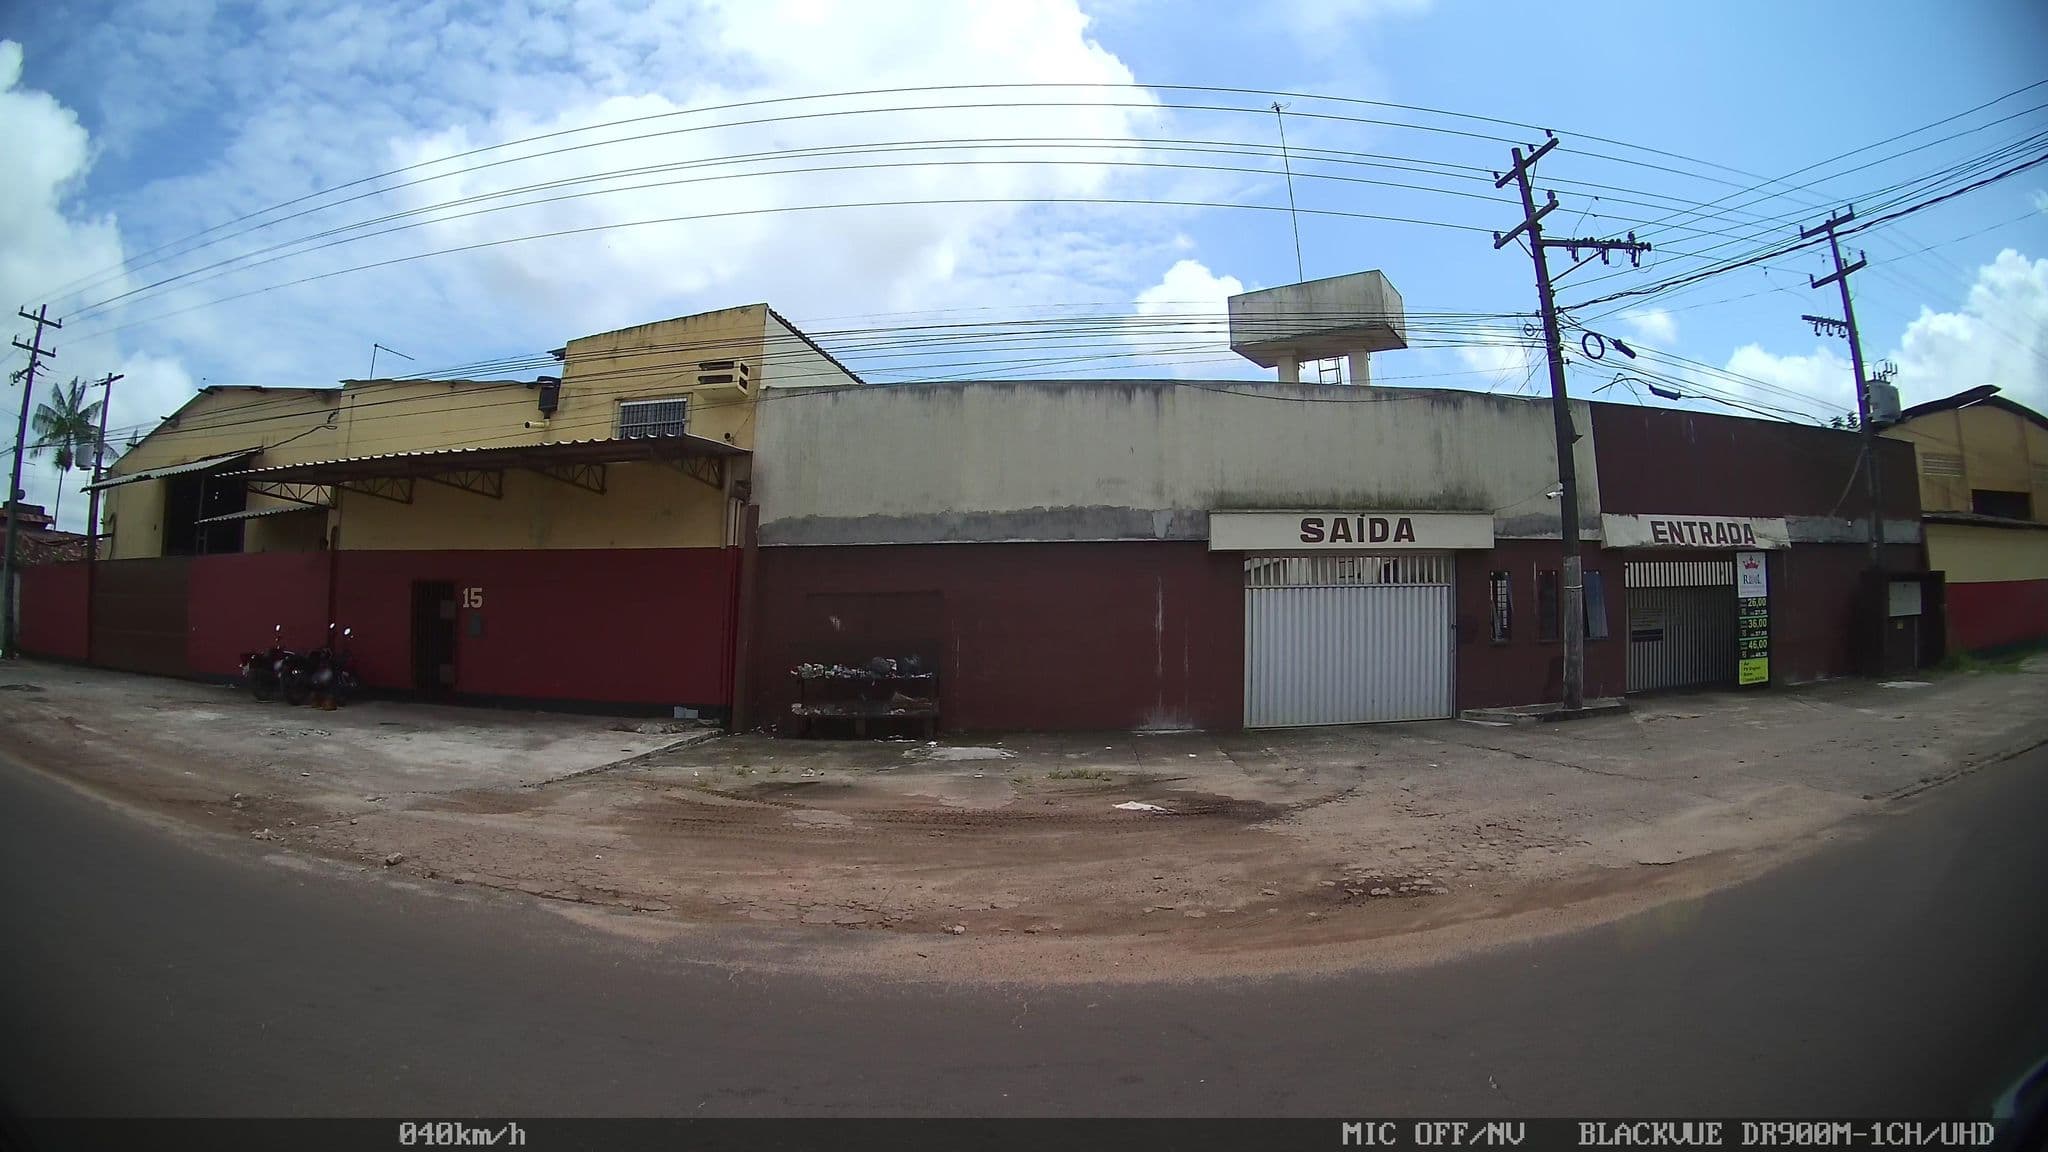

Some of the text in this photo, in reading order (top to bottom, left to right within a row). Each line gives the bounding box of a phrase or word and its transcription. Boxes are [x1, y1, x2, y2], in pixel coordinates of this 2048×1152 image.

[1300, 513, 1416, 543] SAÍDA
[1650, 520, 1756, 545] ENTRADA
[463, 587, 483, 608] 15
